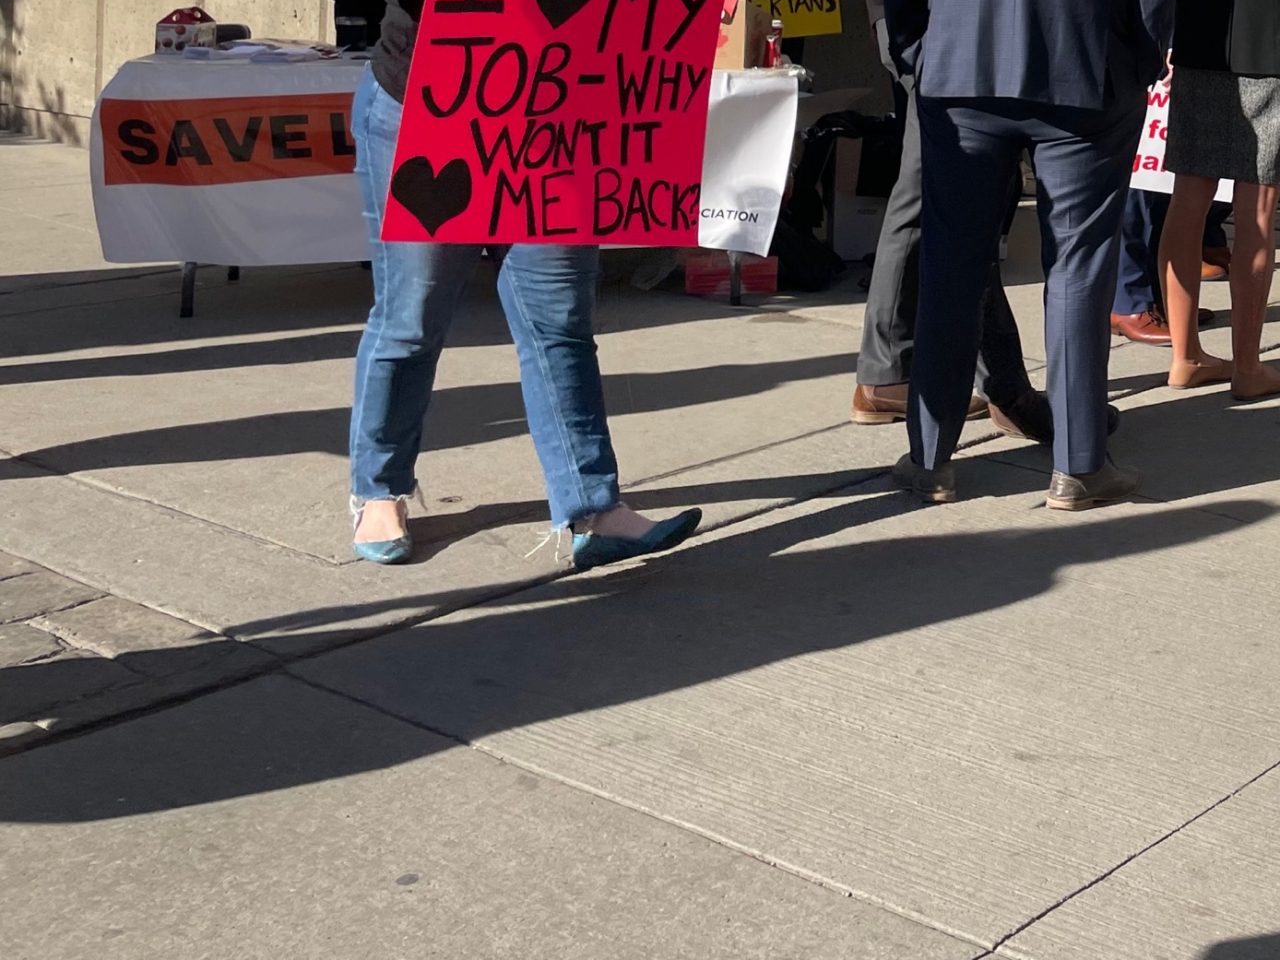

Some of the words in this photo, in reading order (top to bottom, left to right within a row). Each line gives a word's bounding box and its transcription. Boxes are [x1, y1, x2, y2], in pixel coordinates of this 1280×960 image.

[117, 113, 312, 166] SAVE
[620, 121, 662, 166] IT
[489, 170, 577, 237] ME
[594, 168, 700, 237] BACK?
[701, 208, 759, 224] CIATION
